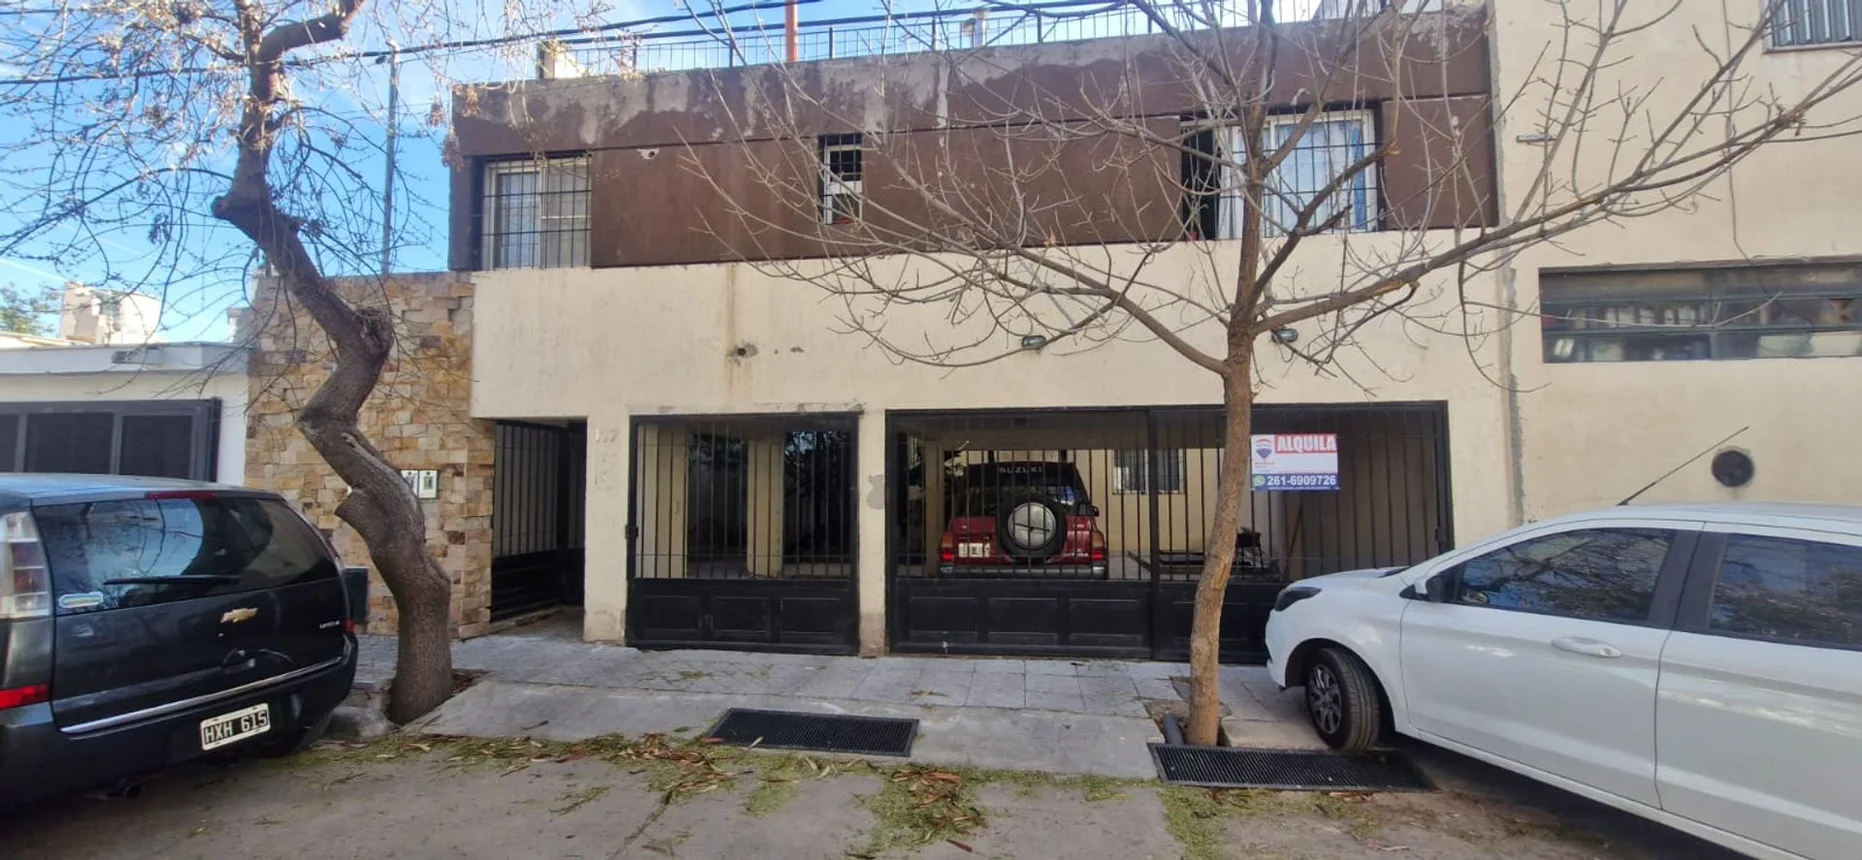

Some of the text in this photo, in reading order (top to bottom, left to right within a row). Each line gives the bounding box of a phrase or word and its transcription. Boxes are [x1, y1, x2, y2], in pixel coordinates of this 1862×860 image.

[1277, 435, 1337, 452] ALQUILA
[999, 466, 1043, 474] SUZUKI
[1267, 475, 1337, 486] 261-6909726
[204, 710, 267, 743] HXH 615
